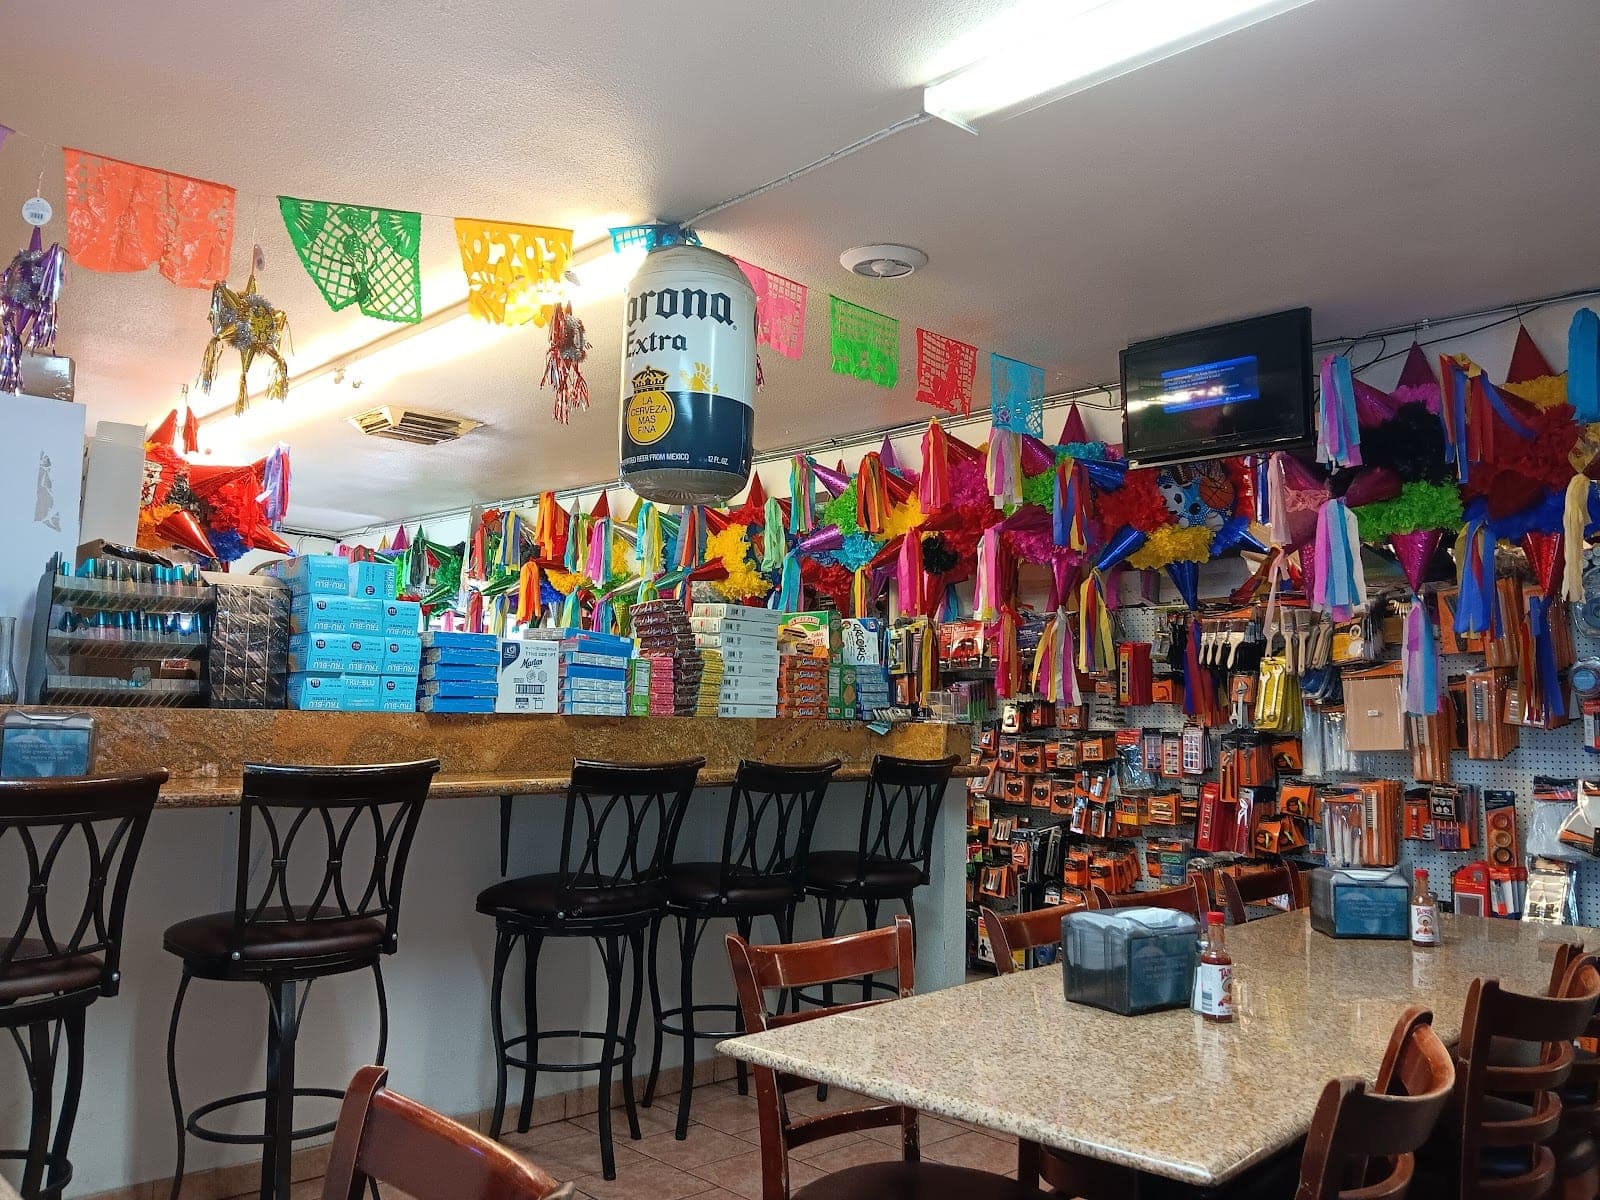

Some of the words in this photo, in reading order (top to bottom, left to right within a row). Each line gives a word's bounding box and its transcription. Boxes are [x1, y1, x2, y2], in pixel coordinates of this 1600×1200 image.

[627, 288, 734, 326] orona
[626, 330, 688, 359] Extra
[642, 396, 653, 405] LA
[630, 404, 668, 417] CERVEZA
[637, 415, 656, 425] MAS
[637, 425, 657, 435] FINA
[649, 452, 666, 461] FROM
[666, 452, 690, 461] MEXICO
[707, 455, 714, 463] 12
[314, 580, 346, 590] TRU-BLU
[314, 621, 345, 632] TRU-BLU
[349, 623, 379, 633] TRU-BLU
